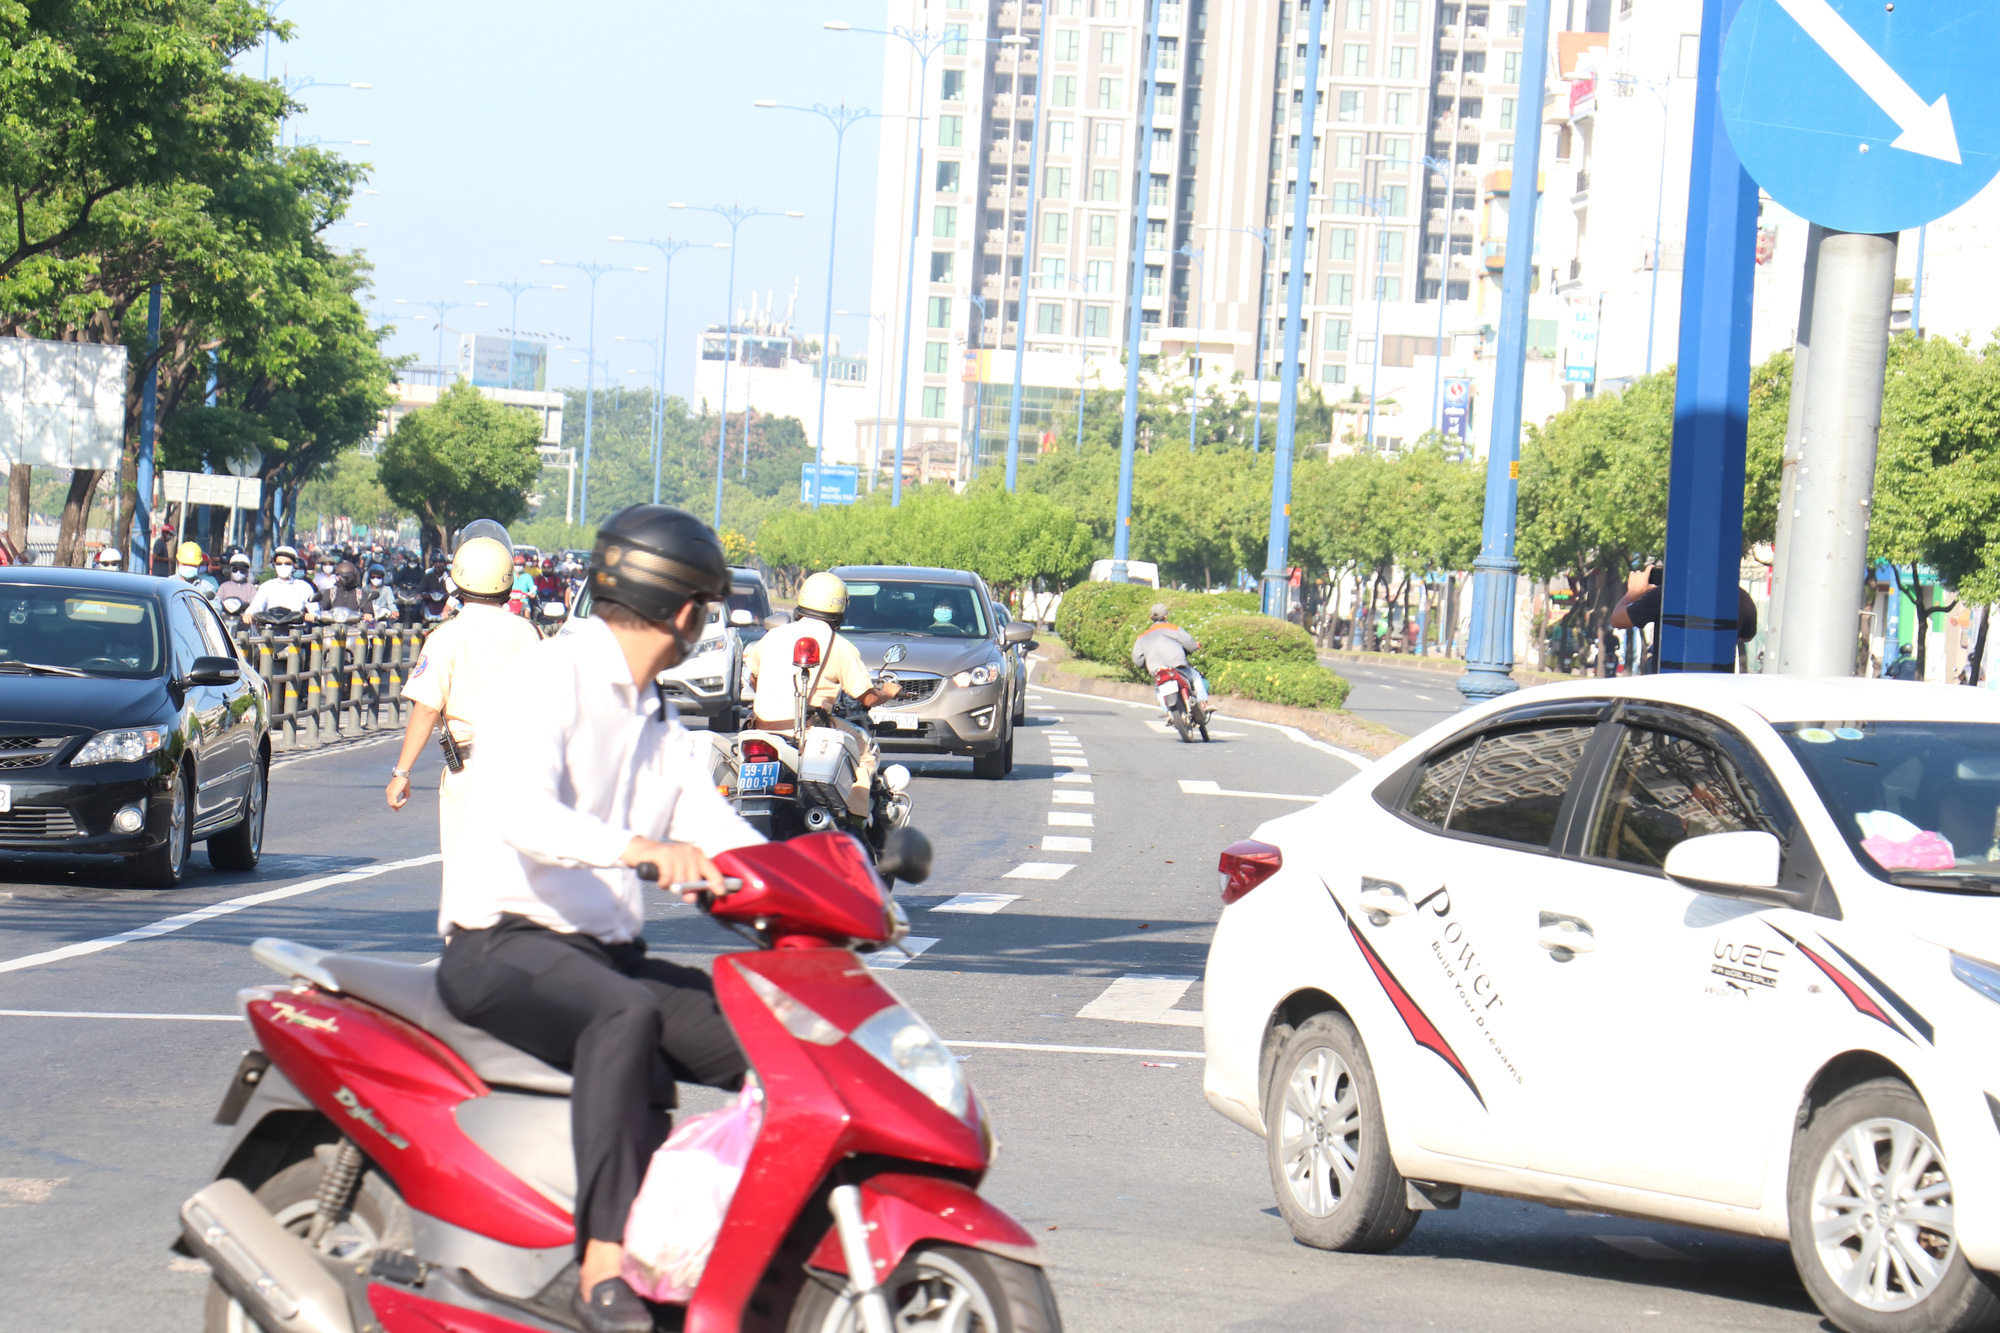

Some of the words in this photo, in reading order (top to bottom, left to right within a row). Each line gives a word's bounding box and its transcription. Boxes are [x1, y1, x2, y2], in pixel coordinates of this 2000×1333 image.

[1413, 882, 1503, 1010] Power
[1432, 941, 1455, 978] Build
[1455, 980, 1476, 1013] Your
